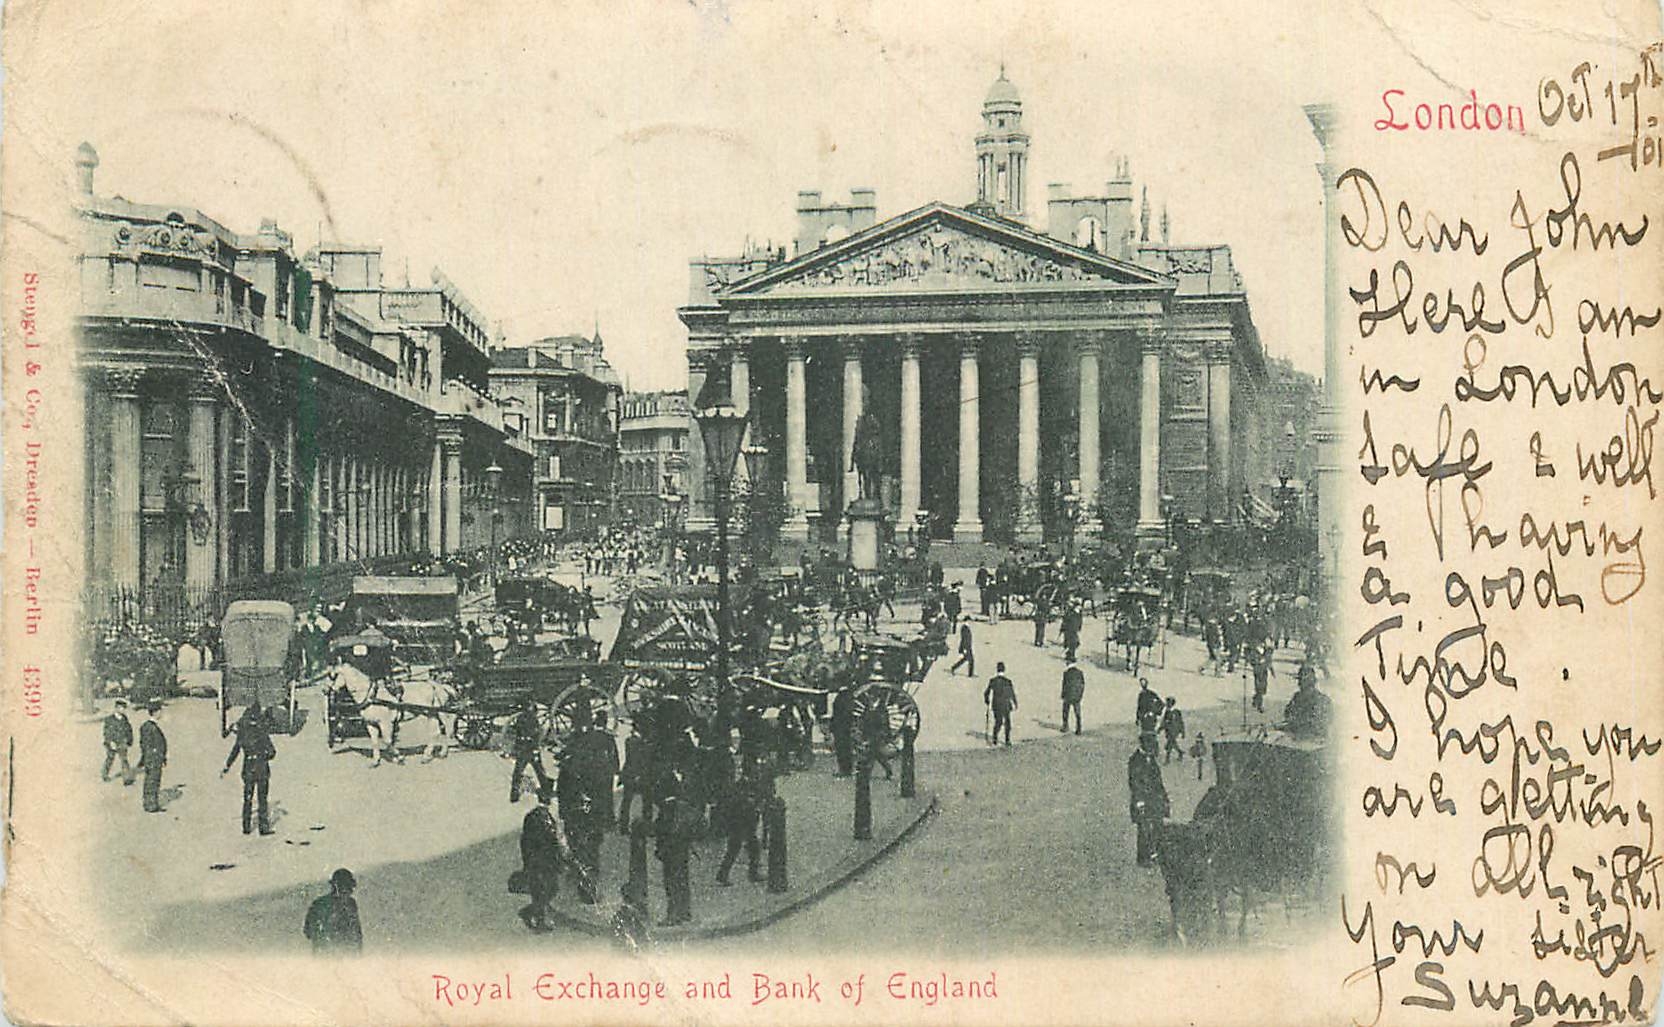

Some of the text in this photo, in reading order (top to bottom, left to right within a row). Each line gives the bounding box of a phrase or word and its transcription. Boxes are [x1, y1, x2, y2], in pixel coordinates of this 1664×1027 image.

[1374, 88, 1526, 136] London
[1336, 152, 1650, 275] Dear John
[1349, 260, 1506, 338] Here
[1578, 299, 1662, 338] am
[25, 361, 42, 377] &
[1358, 333, 1664, 408] in London
[26, 442, 41, 528] Dresden
[1529, 430, 1556, 478] &
[1576, 404, 1661, 500] well
[1460, 484, 1647, 606] having
[26, 567, 42, 635] Berlin
[1360, 546, 1585, 672] a good
[1360, 675, 1662, 827] I hope you
[1362, 760, 1657, 870] are getting
[1375, 851, 1437, 895] on
[432, 972, 998, 1006] Royal Exchange and Bank of England
